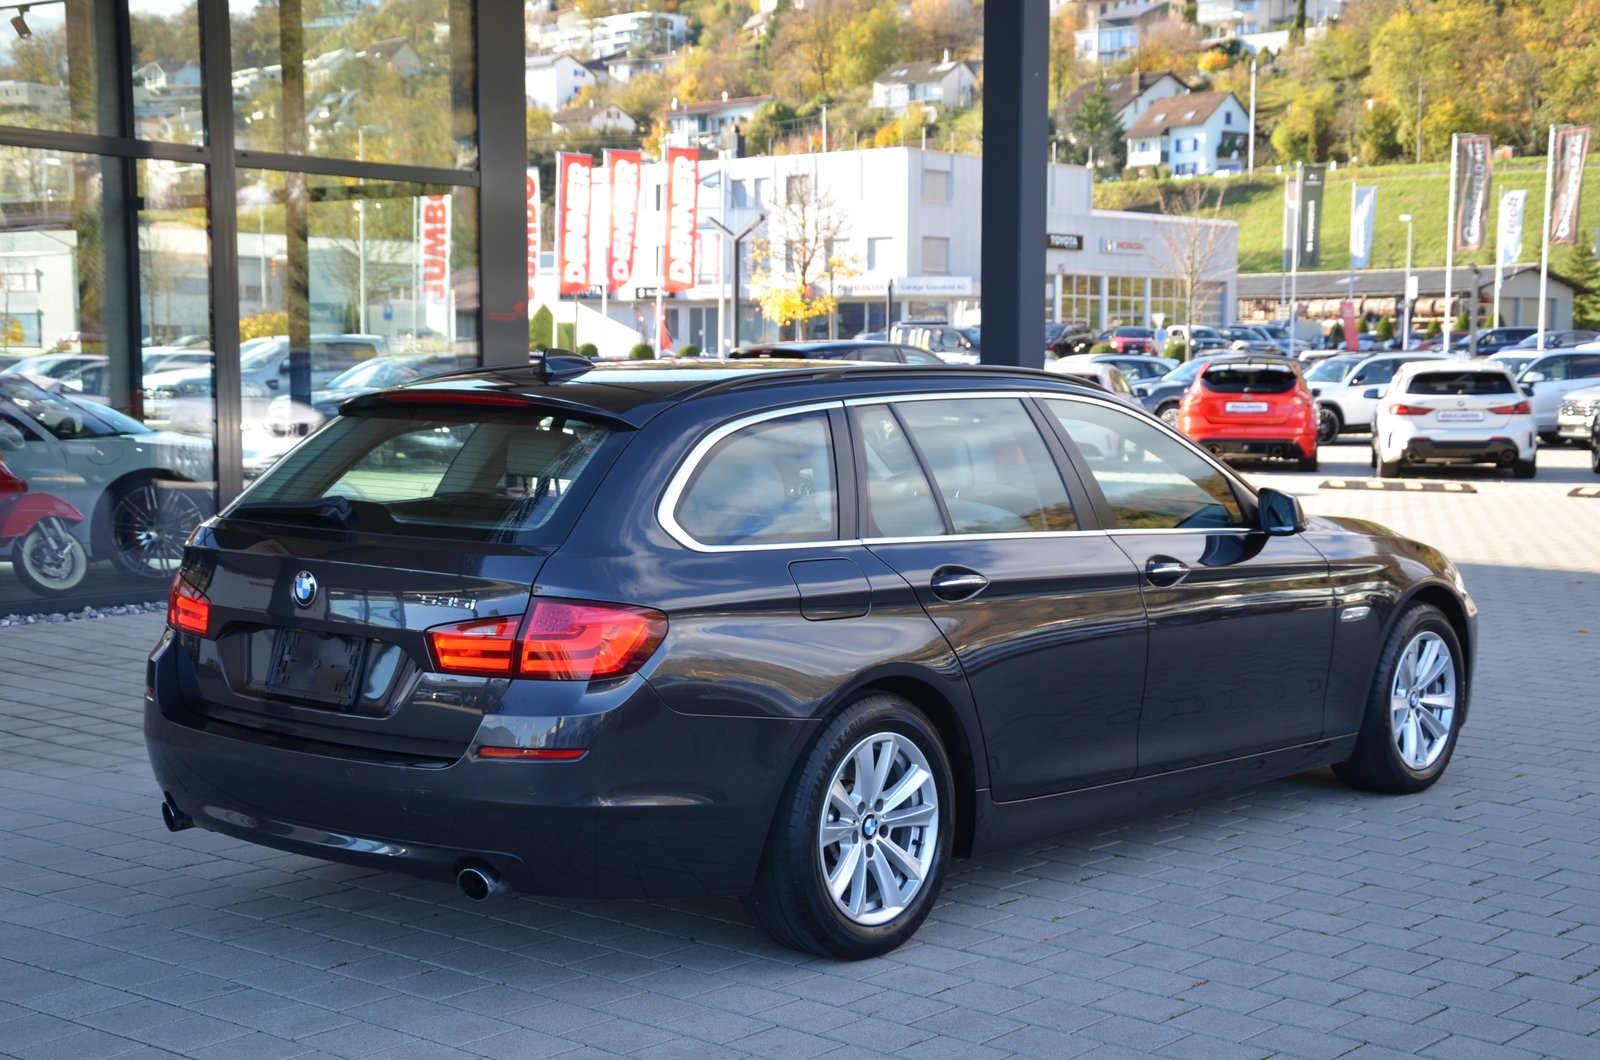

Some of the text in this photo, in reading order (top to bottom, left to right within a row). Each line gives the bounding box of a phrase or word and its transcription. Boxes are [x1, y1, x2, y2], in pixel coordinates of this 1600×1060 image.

[563, 162, 590, 284] DENNER
[611, 159, 638, 281] DENNER
[669, 156, 695, 284] DENNER
[1050, 235, 1078, 247] TOYOTA
